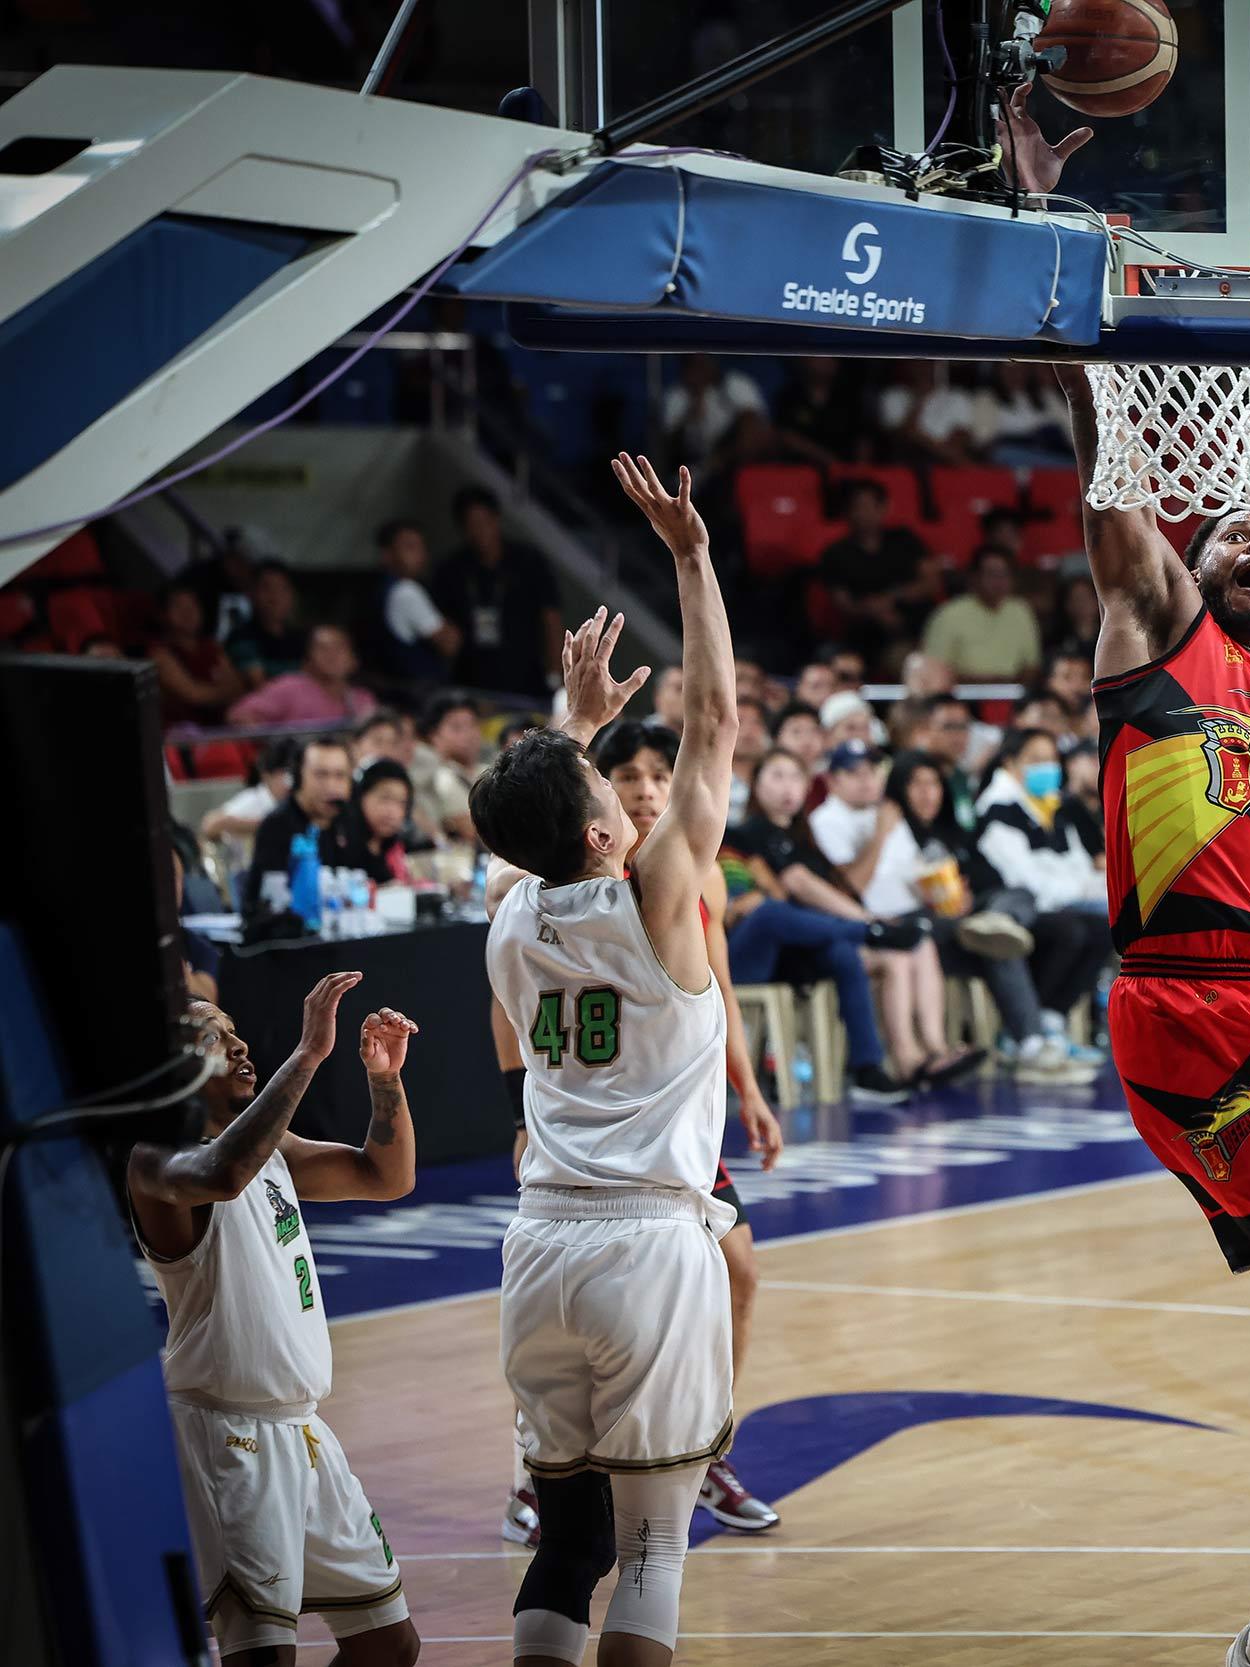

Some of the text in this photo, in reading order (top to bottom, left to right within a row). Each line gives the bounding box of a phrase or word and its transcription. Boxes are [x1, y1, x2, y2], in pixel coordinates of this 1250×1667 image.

[782, 281, 926, 327] Schelde Sports
[529, 984, 622, 1069] 48
[294, 1254, 314, 1312] 2
